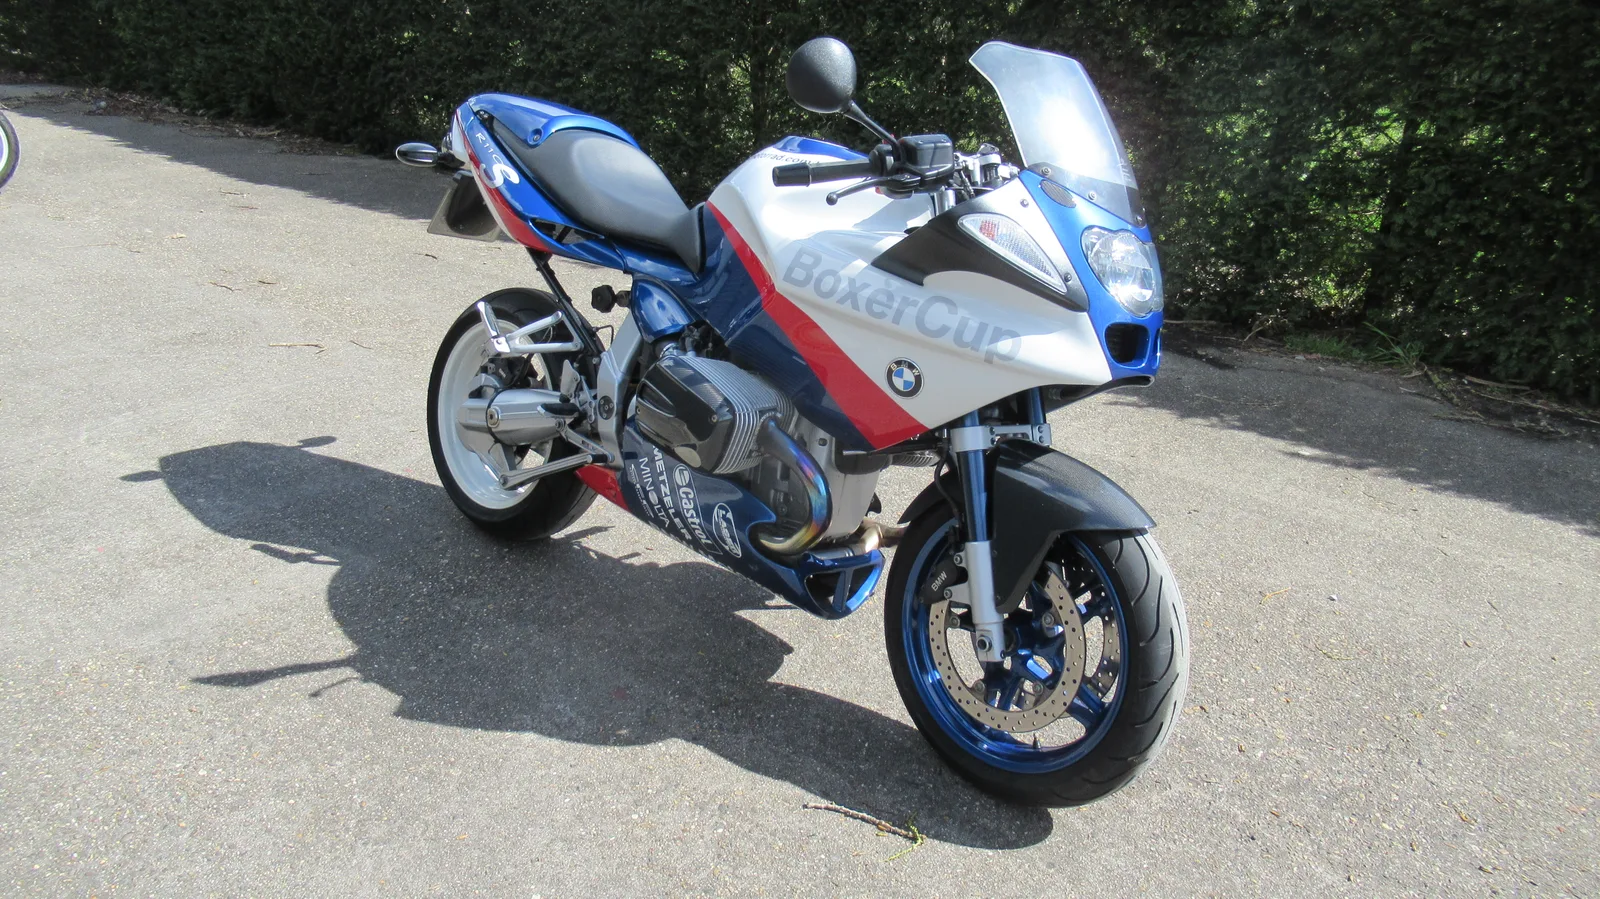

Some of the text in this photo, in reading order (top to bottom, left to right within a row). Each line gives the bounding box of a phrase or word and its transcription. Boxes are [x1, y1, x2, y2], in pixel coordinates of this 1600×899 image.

[783, 250, 1022, 364] BoxerCup
[639, 457, 669, 528] MINOLTA
[652, 445, 693, 541] METZELER
[679, 487, 713, 545] Castrol
[930, 570, 948, 592] BMW
